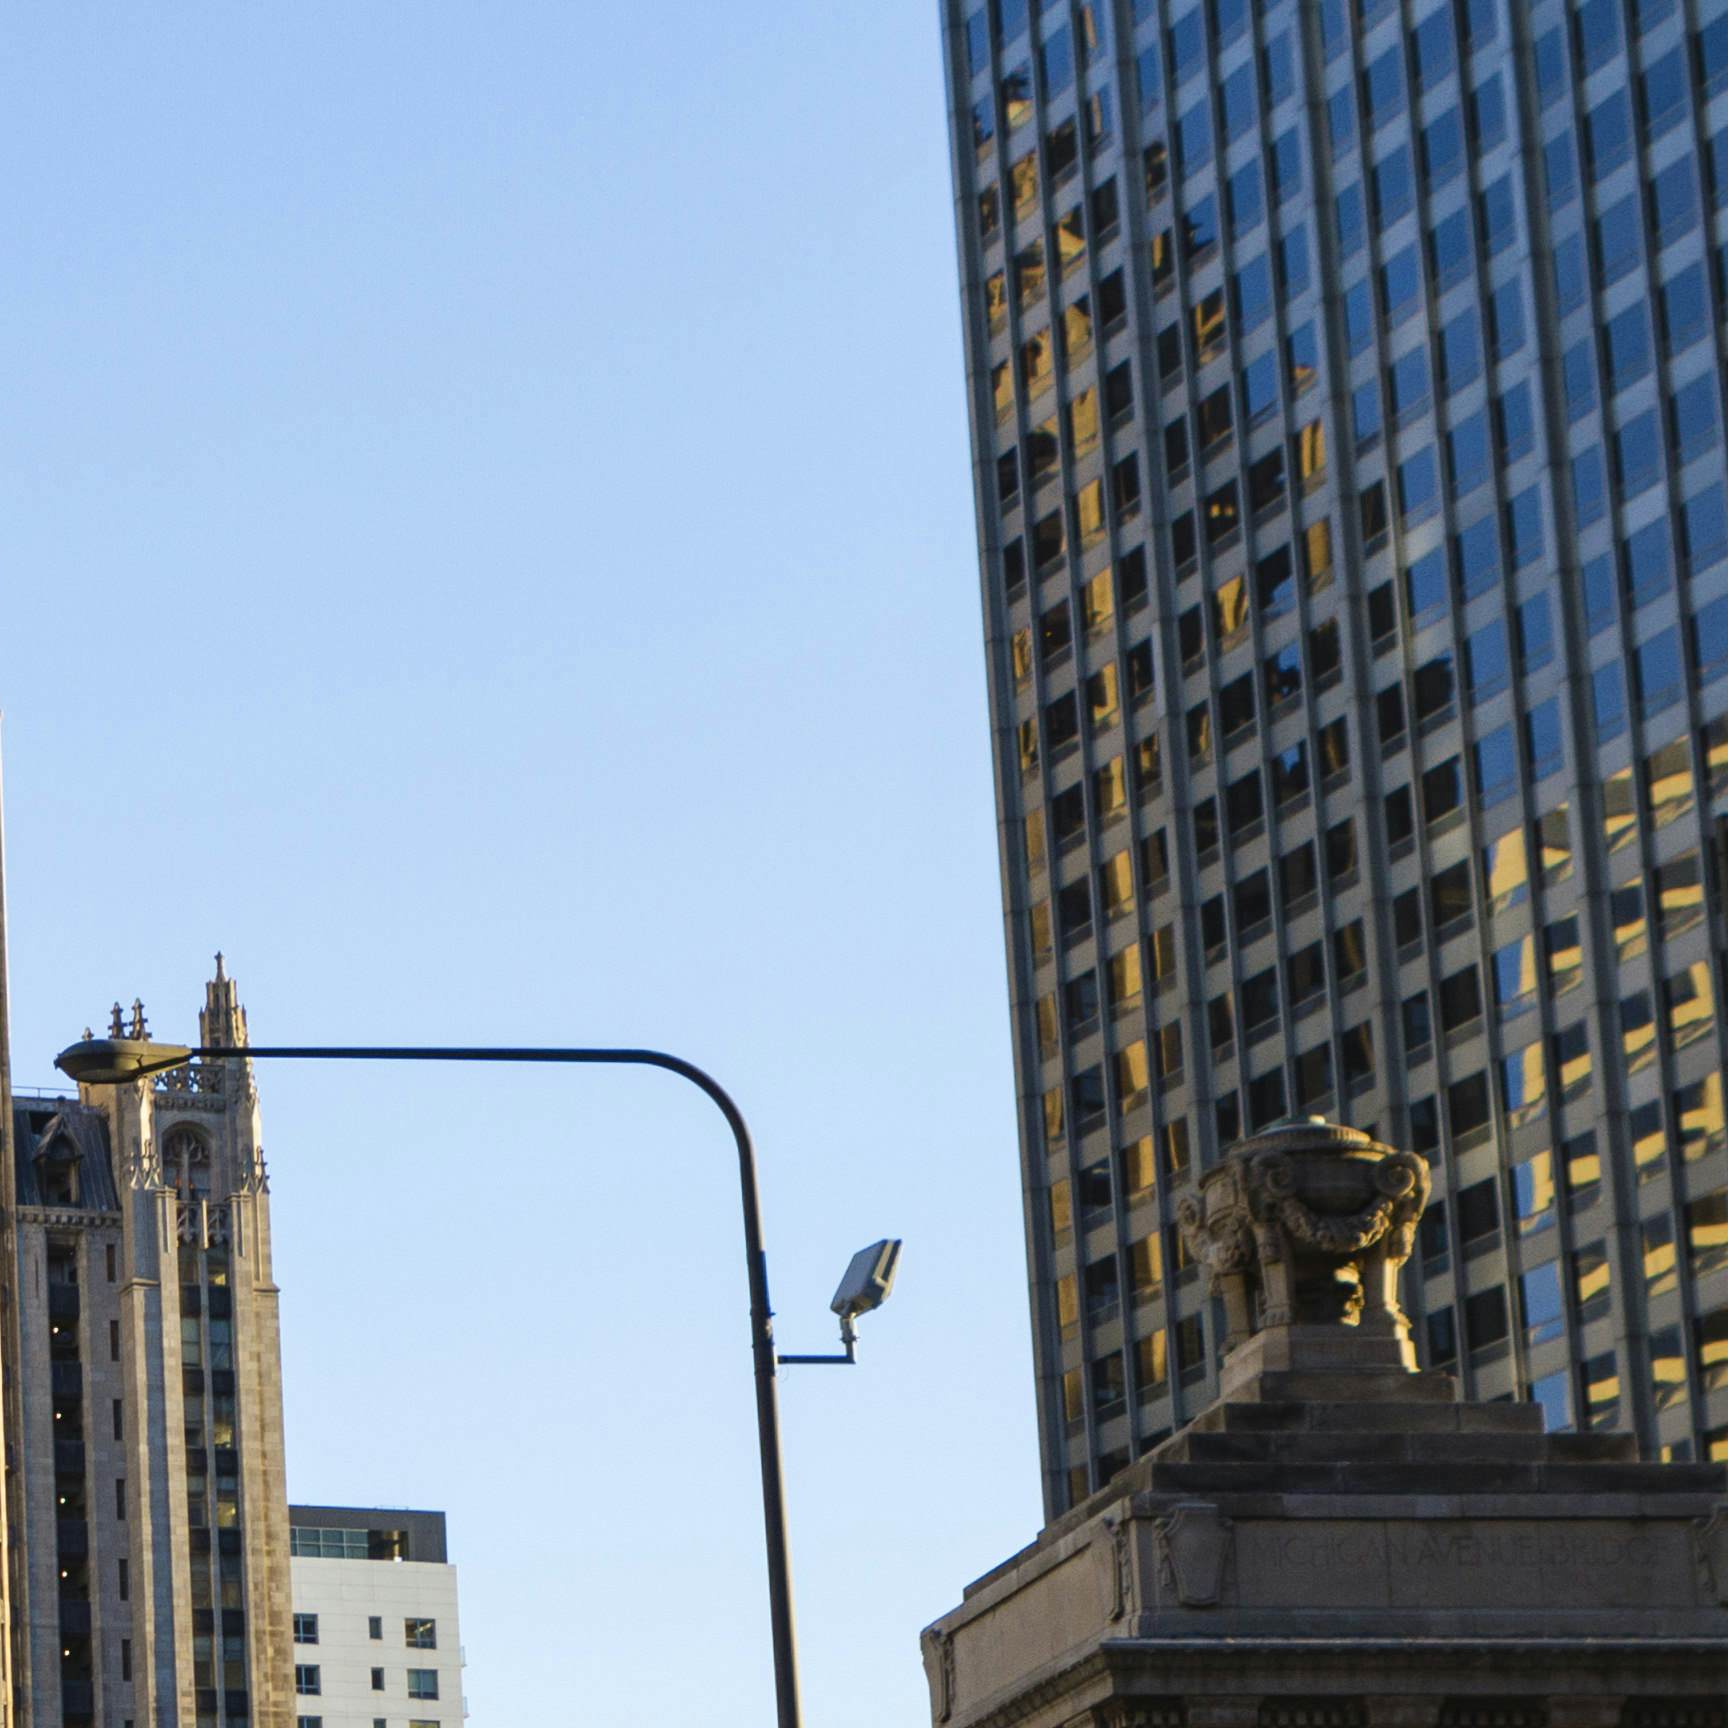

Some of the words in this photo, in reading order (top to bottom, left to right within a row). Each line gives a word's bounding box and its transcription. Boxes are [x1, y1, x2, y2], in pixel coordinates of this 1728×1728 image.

[1250, 1536, 1408, 1567] MICHIGAN
[1416, 1536, 1536, 1567] AVENUE
[1549, 1536, 1666, 1567] BRIDGE
